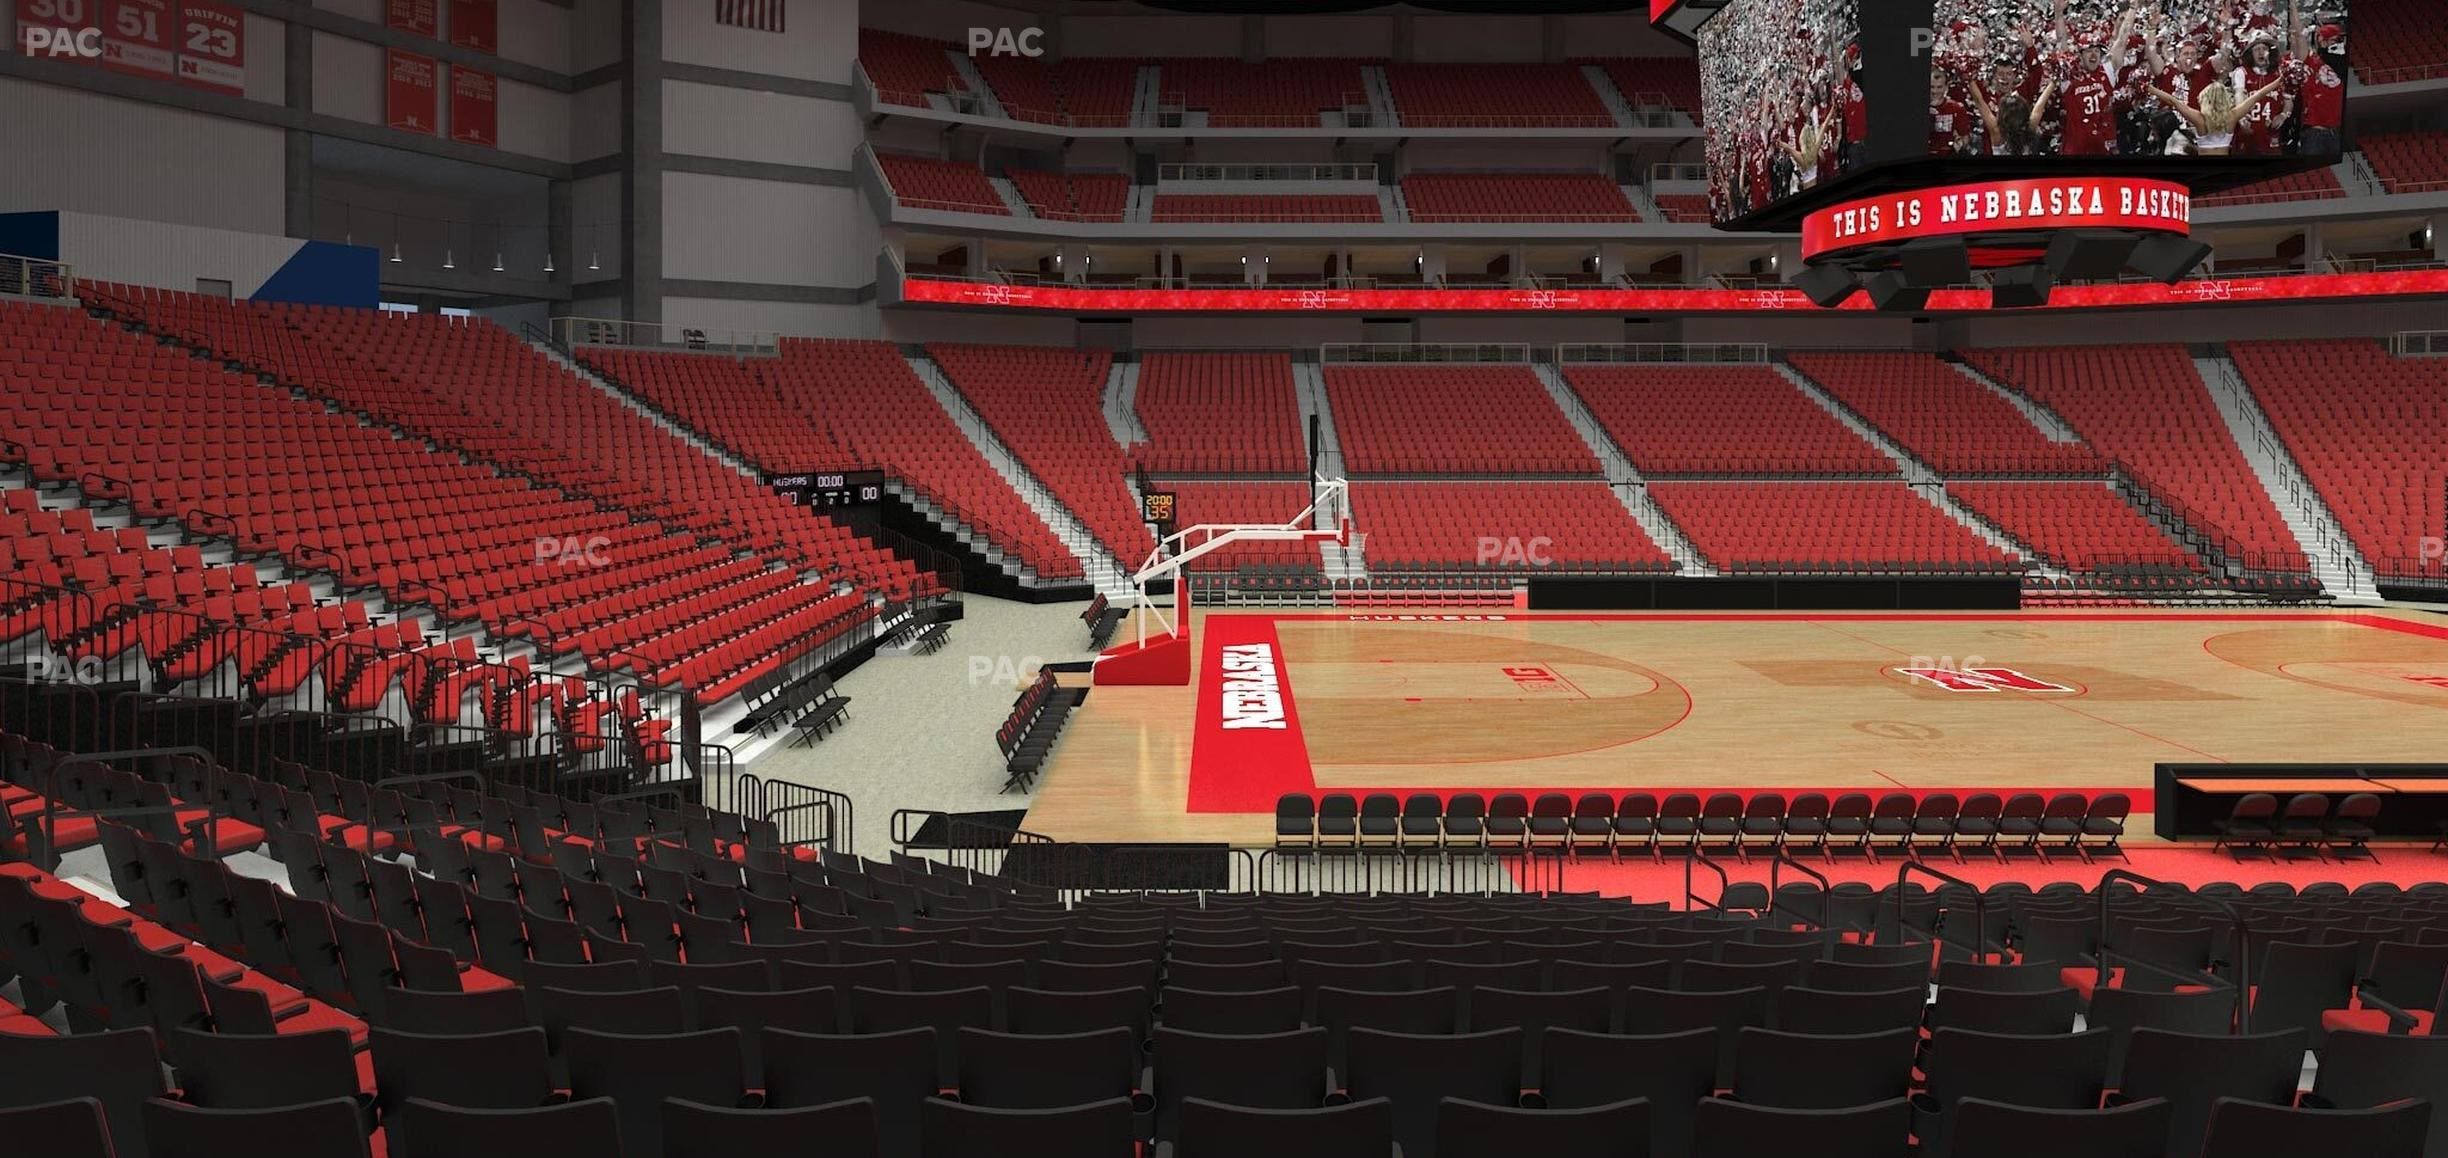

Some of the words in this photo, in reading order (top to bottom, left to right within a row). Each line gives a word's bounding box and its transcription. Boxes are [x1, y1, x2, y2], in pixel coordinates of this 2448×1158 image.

[116, 4, 159, 43] 51
[185, 8, 239, 28] GRIFFIN
[185, 22, 237, 58] 23
[105, 41, 122, 59] N
[181, 60, 198, 75] N
[2083, 95, 2101, 115] 31
[2250, 102, 2272, 122] 24
[1833, 205, 1880, 238] THIS
[1896, 199, 1921, 228] IS
[1940, 186, 2104, 222] NEBRASKA
[1303, 291, 1326, 308] N
[1532, 291, 1556, 308] N
[1760, 291, 1785, 308] N
[2199, 281, 2231, 300] N
[773, 476, 807, 487] HUSKERS
[817, 475, 844, 488] 00:00
[862, 487, 878, 500] 00
[1151, 505, 1168, 519] 35
[1222, 643, 1288, 729] NEBRASKA
